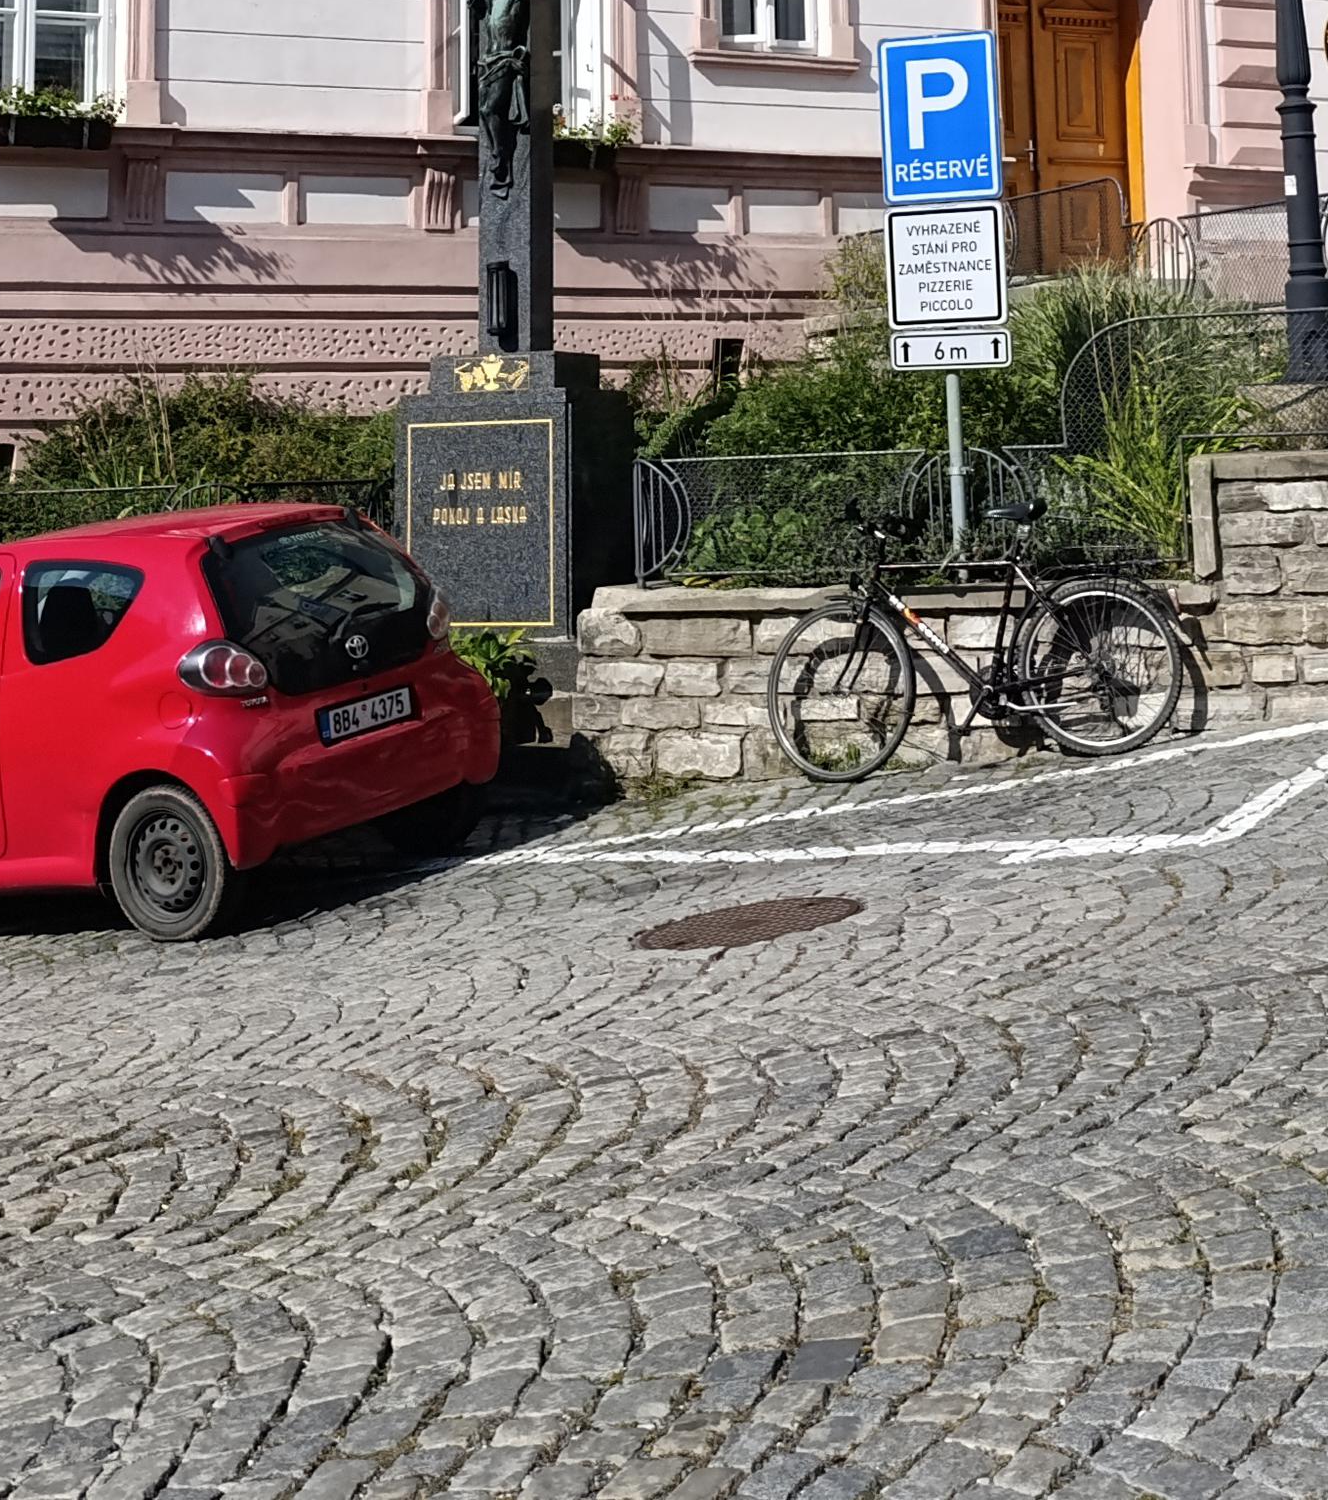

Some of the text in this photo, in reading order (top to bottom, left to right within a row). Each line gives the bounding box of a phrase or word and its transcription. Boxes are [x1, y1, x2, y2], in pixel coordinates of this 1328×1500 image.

[905, 57, 969, 150] P
[895, 154, 989, 183] RÉSERVÉ
[906, 220, 981, 237] VYHRAZENÉ
[912, 240, 978, 256] STÁNÍ PRO
[898, 259, 992, 275] ZAMĚSTNANCE
[918, 279, 974, 293] PIZZERIE
[920, 298, 973, 312] PICCOLO
[460, 472, 491, 490] JSEM
[432, 507, 469, 525] POKOJ
[476, 507, 484, 524] A
[333, 707, 360, 734] 8B4
[371, 692, 404, 722] 4375
